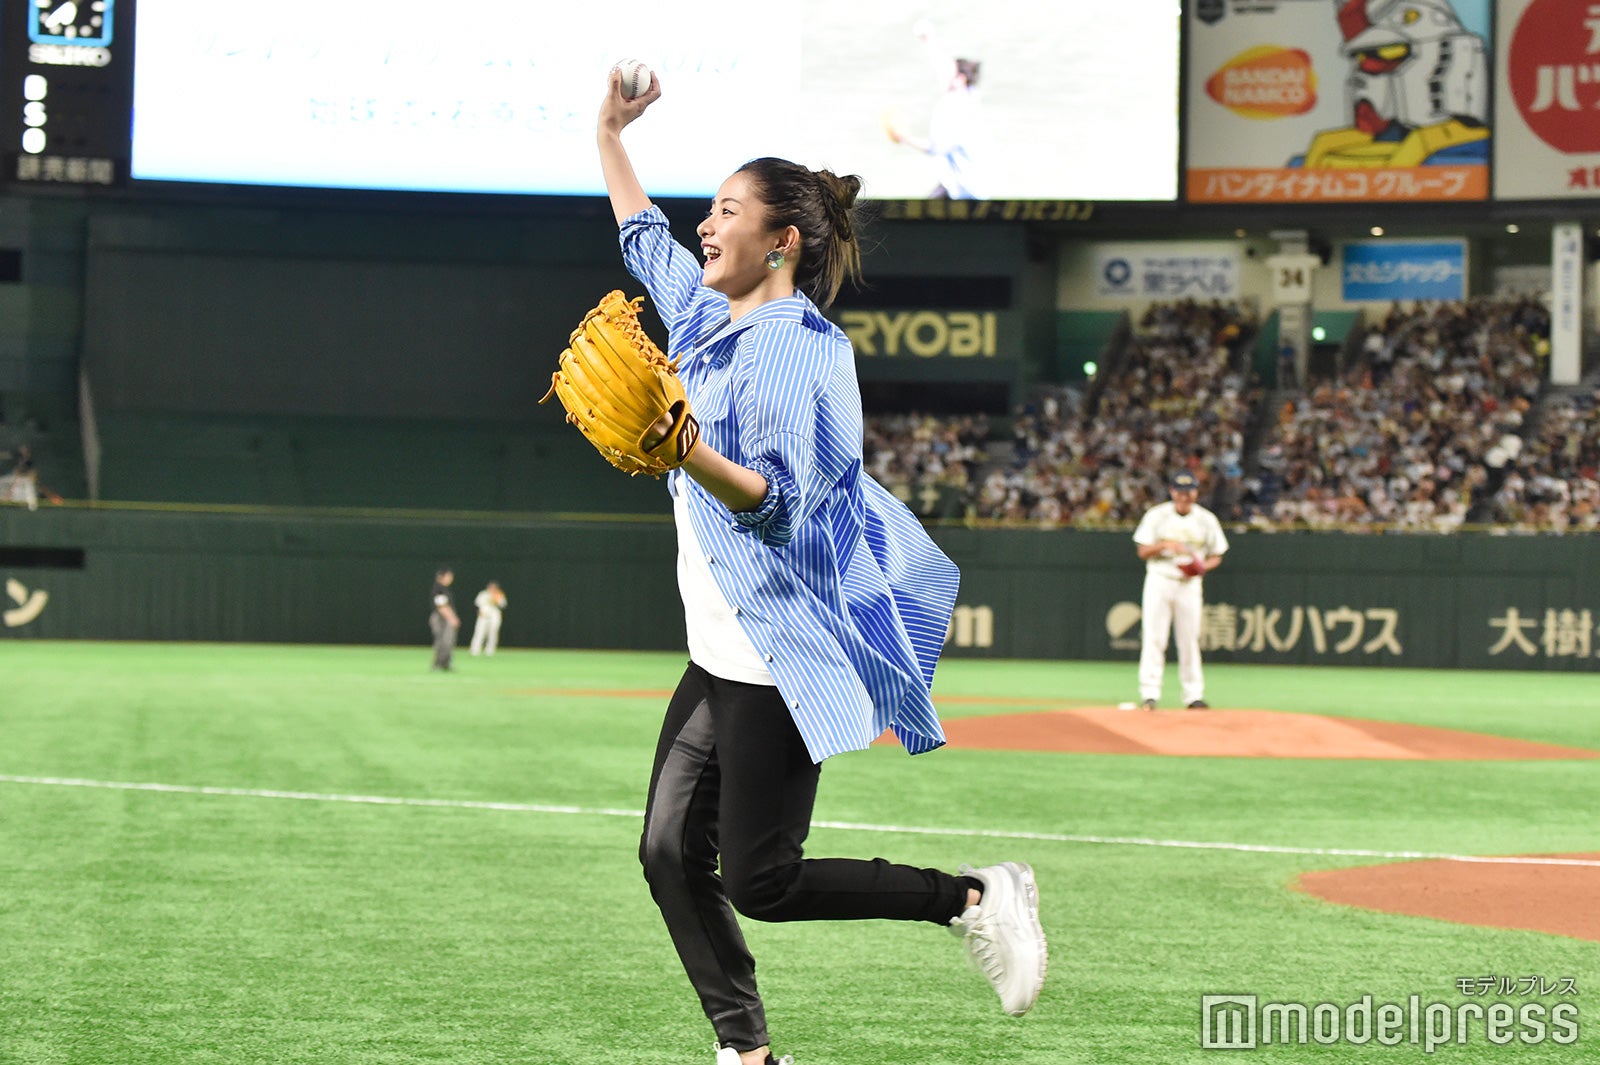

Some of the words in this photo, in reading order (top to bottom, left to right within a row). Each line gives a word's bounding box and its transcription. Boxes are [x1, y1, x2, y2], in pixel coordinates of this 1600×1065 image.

[1224, 67, 1305, 84] BANDAI
[1224, 86, 1307, 105] NAMCO
[840, 311, 996, 359] RYOBI
[1199, 605, 1402, 656] 積水ハウス
[1488, 608, 1600, 659] 大樹
